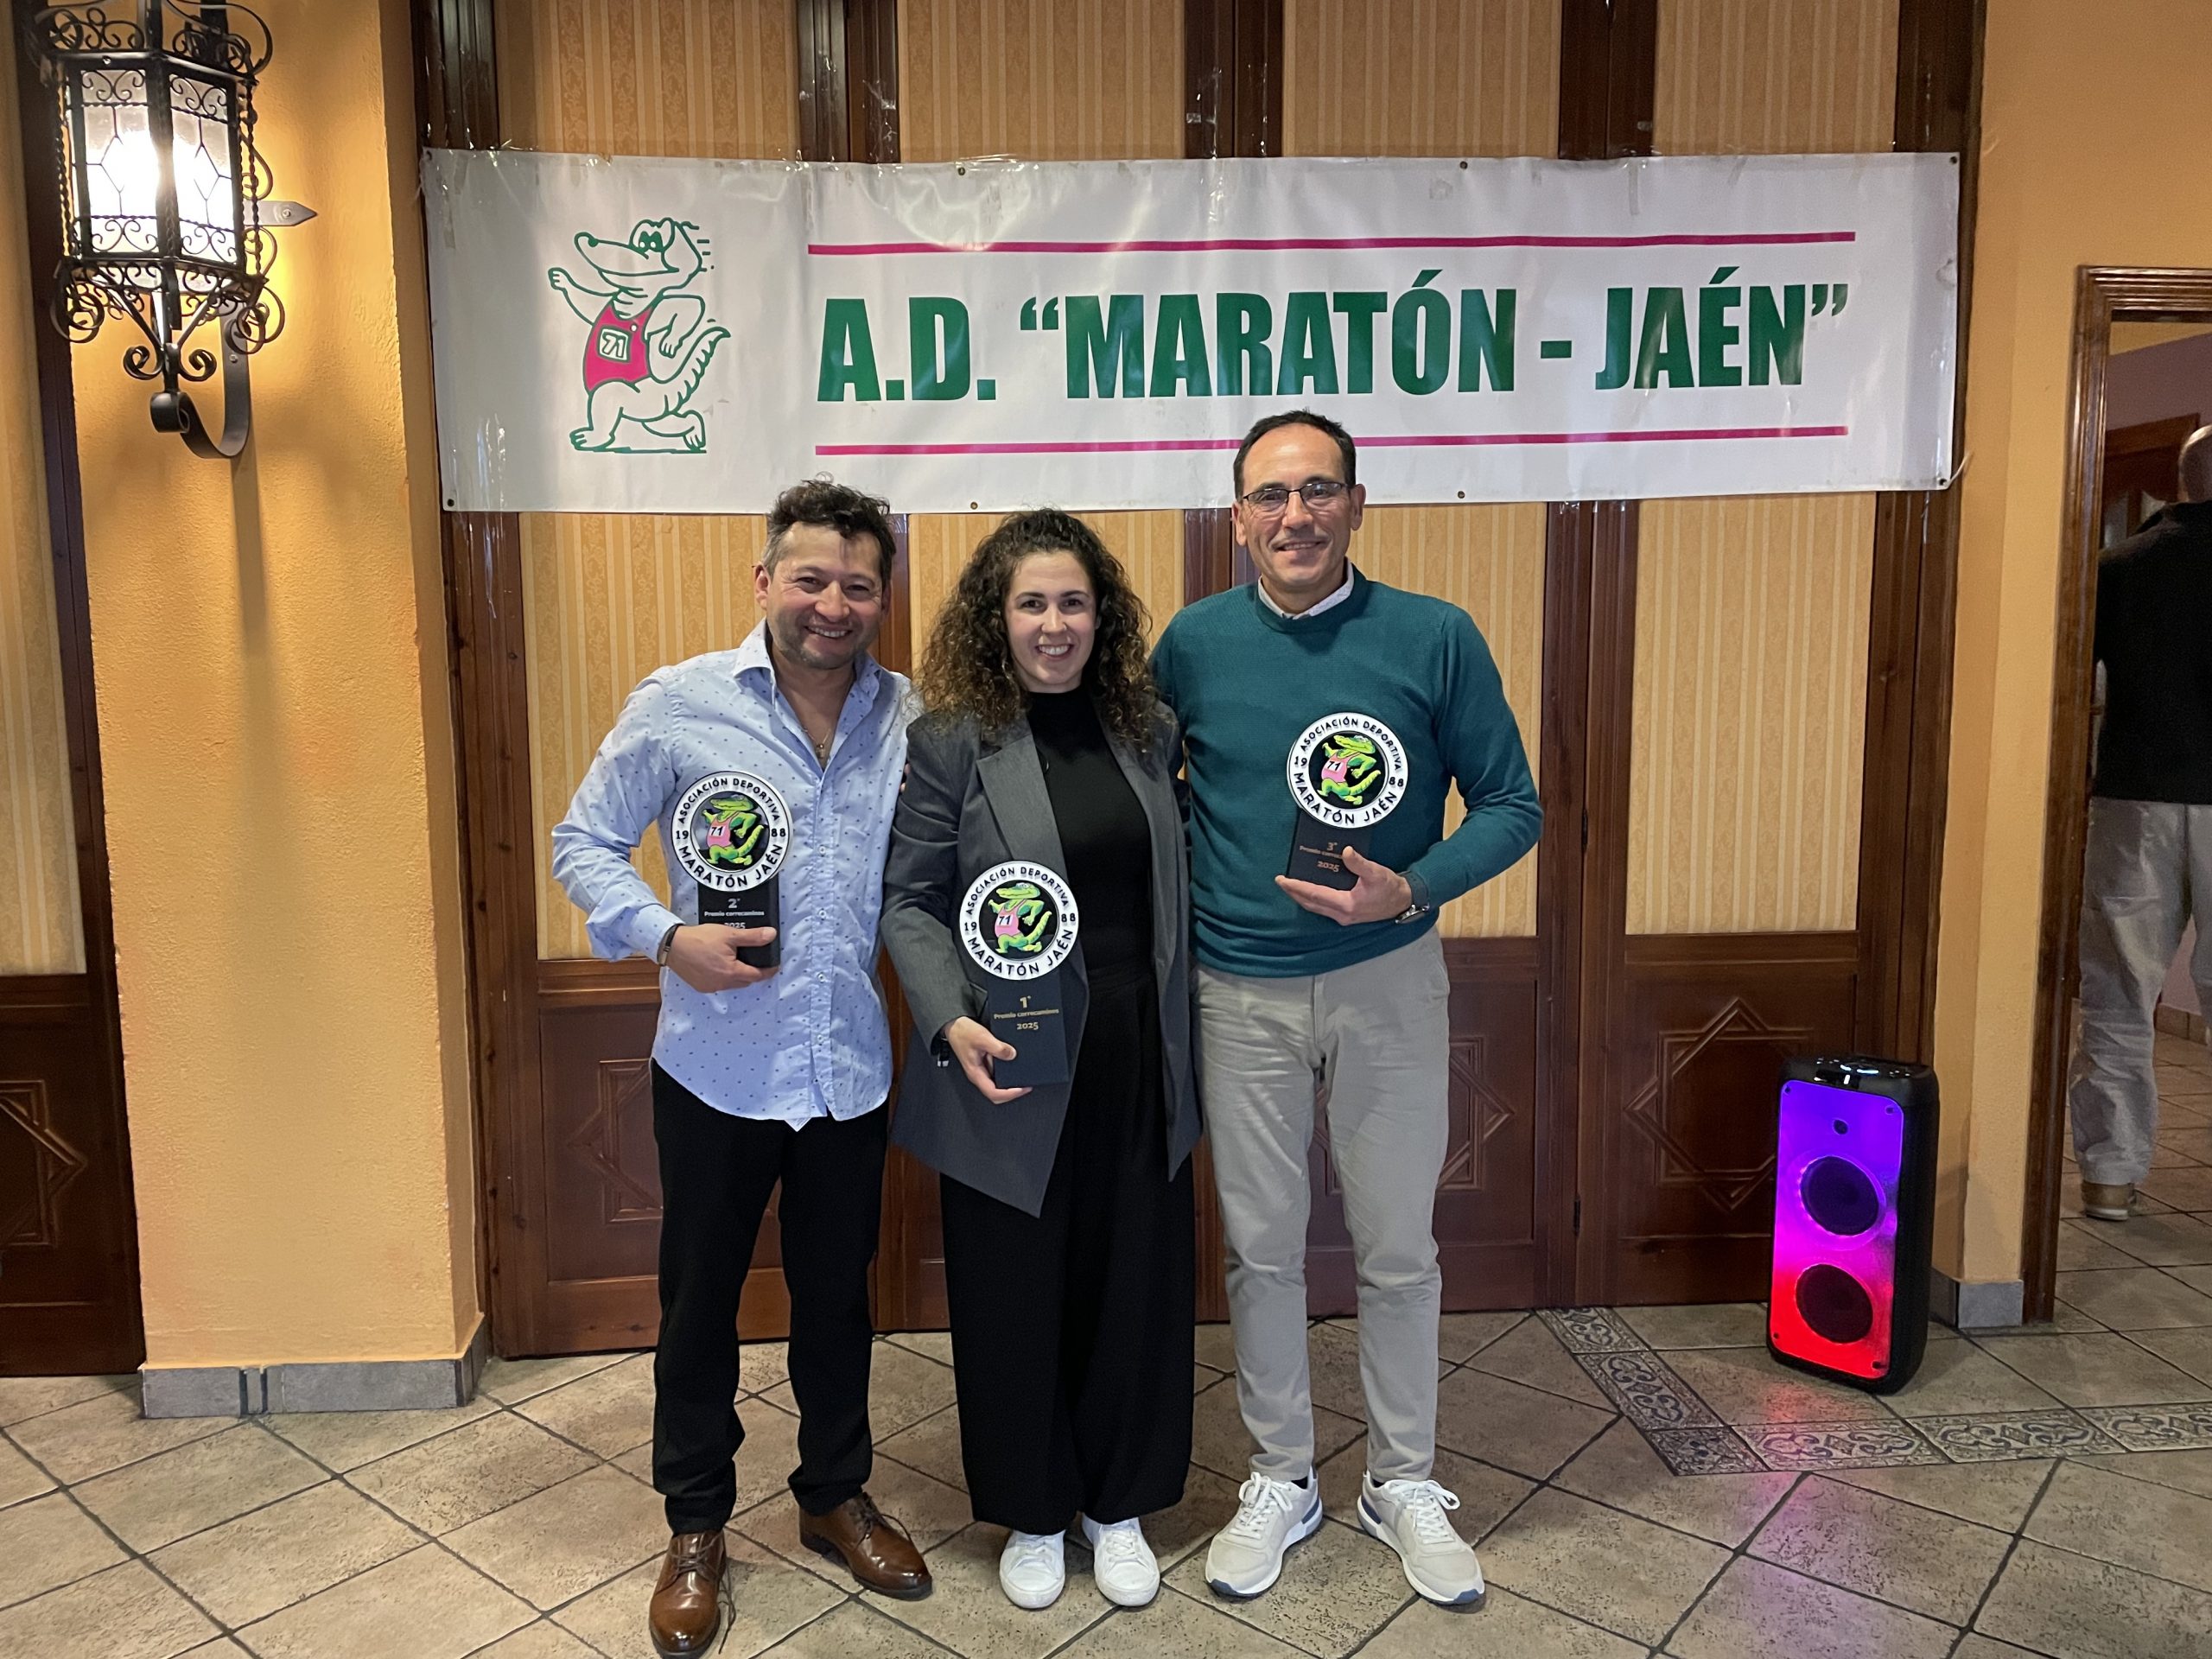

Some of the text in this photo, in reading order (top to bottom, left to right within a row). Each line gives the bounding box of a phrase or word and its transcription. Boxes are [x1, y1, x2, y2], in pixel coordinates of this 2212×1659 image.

[601, 331, 627, 359] 71
[817, 296, 997, 402] A.D.
[1300, 716, 1402, 771] ASOCIACIÓN DEPORTIVA
[1294, 756, 1404, 788] 19 88
[1327, 760, 1341, 772] 71
[679, 778, 780, 824] ASOCIACIÓN DEPORTIVA
[1294, 772, 1397, 824] MARATÓN JAÉN
[676, 828, 786, 839] 19 88
[710, 826, 724, 836] 71
[679, 844, 783, 887] MARATÓN JAÉN
[1317, 861, 1340, 872] 2025
[966, 867, 1070, 915] ASOCIACIÓN DEPORTIVA
[963, 912, 1076, 931] 19 88
[999, 915, 1011, 925] 71
[967, 929, 1073, 976] MARATÓN JAÉN
[1016, 1021, 1039, 1031] 2025
